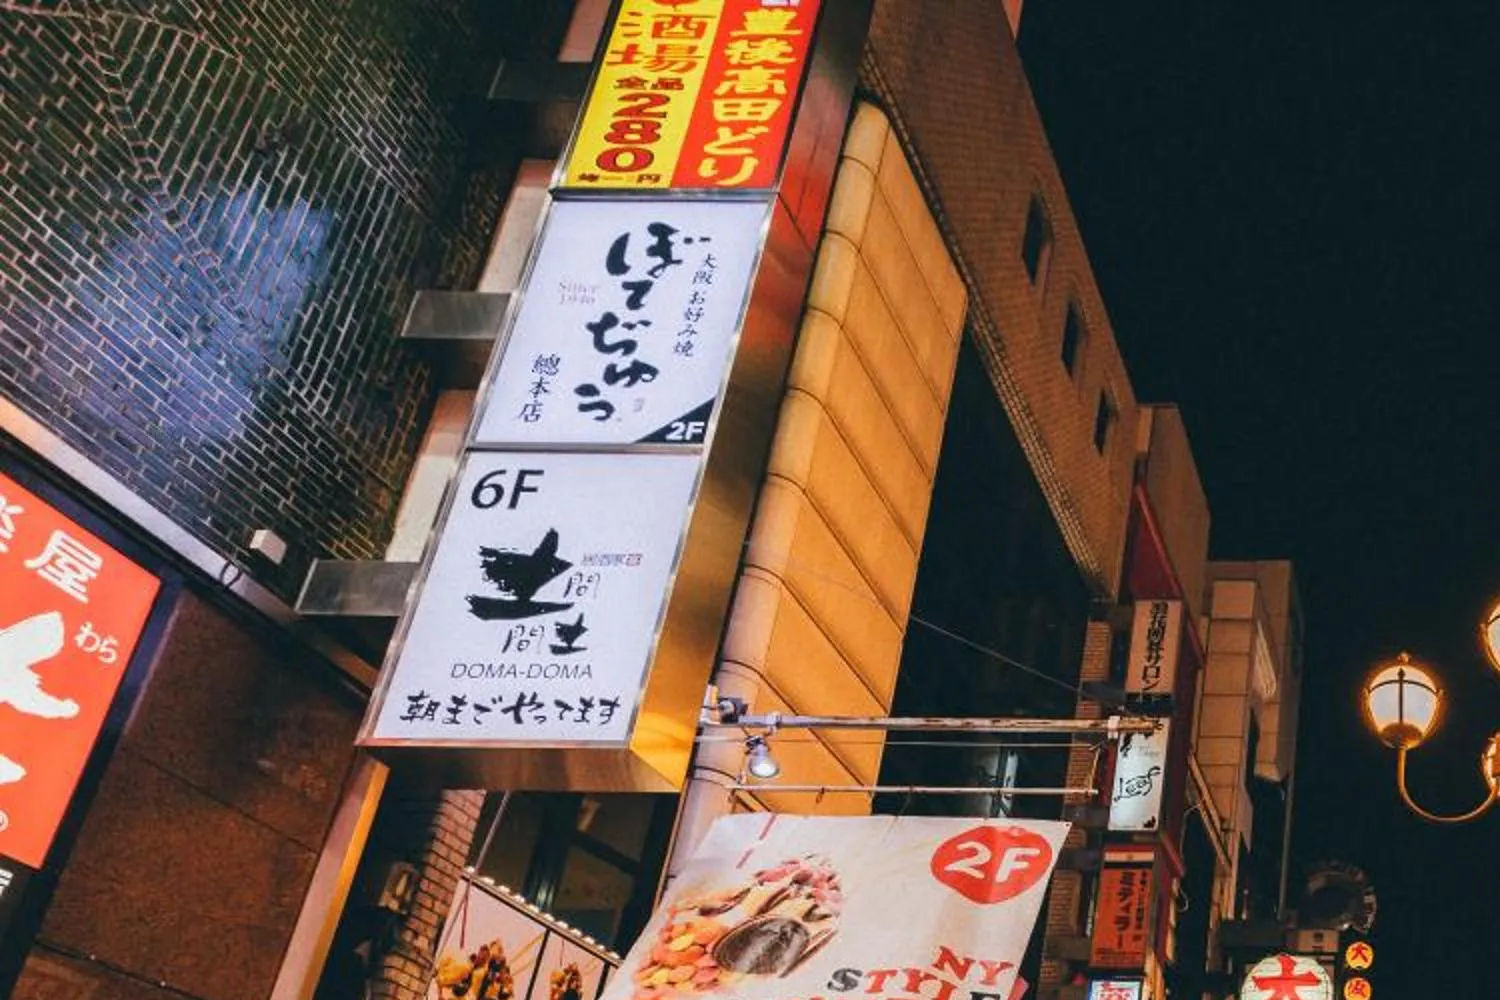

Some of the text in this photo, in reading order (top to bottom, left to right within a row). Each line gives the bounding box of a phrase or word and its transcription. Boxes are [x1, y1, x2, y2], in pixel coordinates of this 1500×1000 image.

[613, 76, 684, 91] 全品
[699, 9, 803, 186] 豊後高田どり
[596, 93, 671, 172] 280
[665, 422, 705, 441] 2F
[471, 468, 544, 510] 6F
[74, 621, 118, 664] わら
[451, 662, 593, 680] DOMA-DOMA
[400, 690, 621, 725] 朝までやってます
[944, 841, 1041, 883] 2F
[932, 945, 1015, 986] NY
